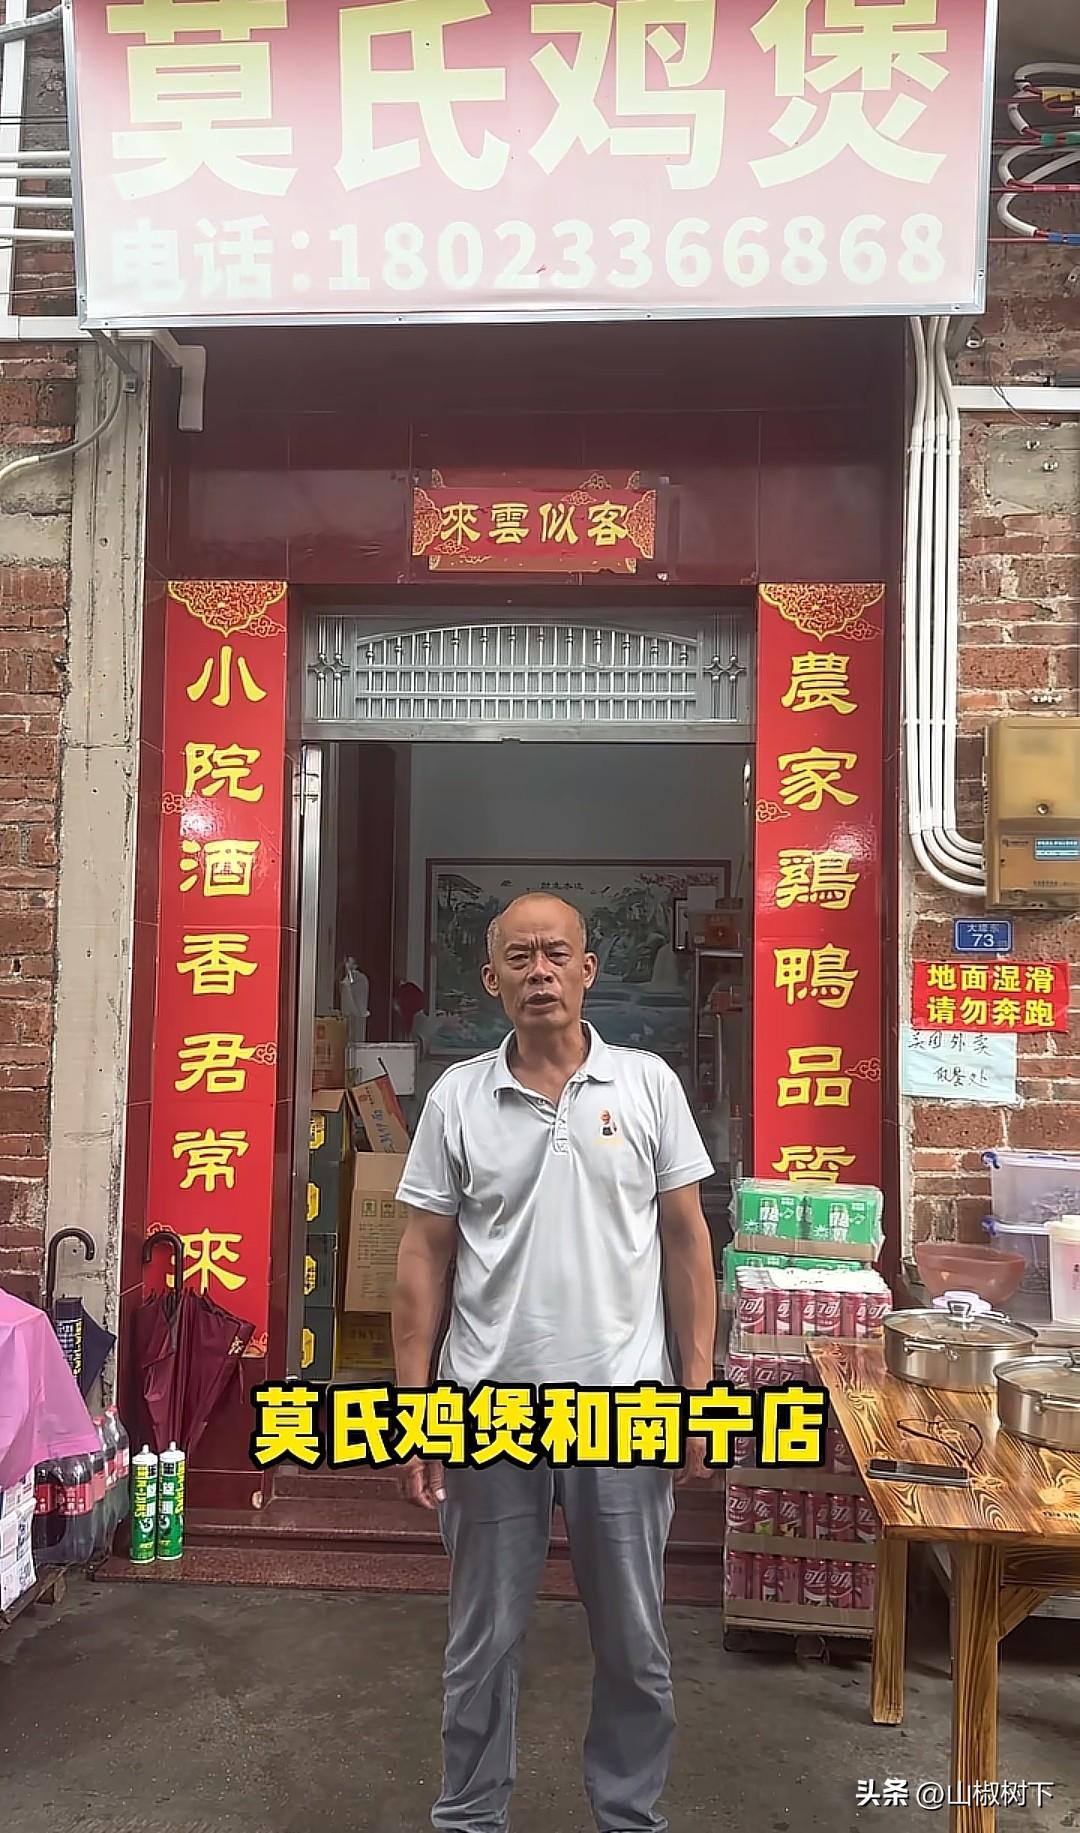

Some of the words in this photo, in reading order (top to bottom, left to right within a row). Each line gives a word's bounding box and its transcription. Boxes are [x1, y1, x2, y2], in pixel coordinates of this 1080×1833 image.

[107, 0, 949, 197] 莫氏鸡煲
[972, 933, 994, 947] 73
[927, 963, 1054, 994] 地面湿滑
[926, 995, 1055, 1027] 请勿奔跑
